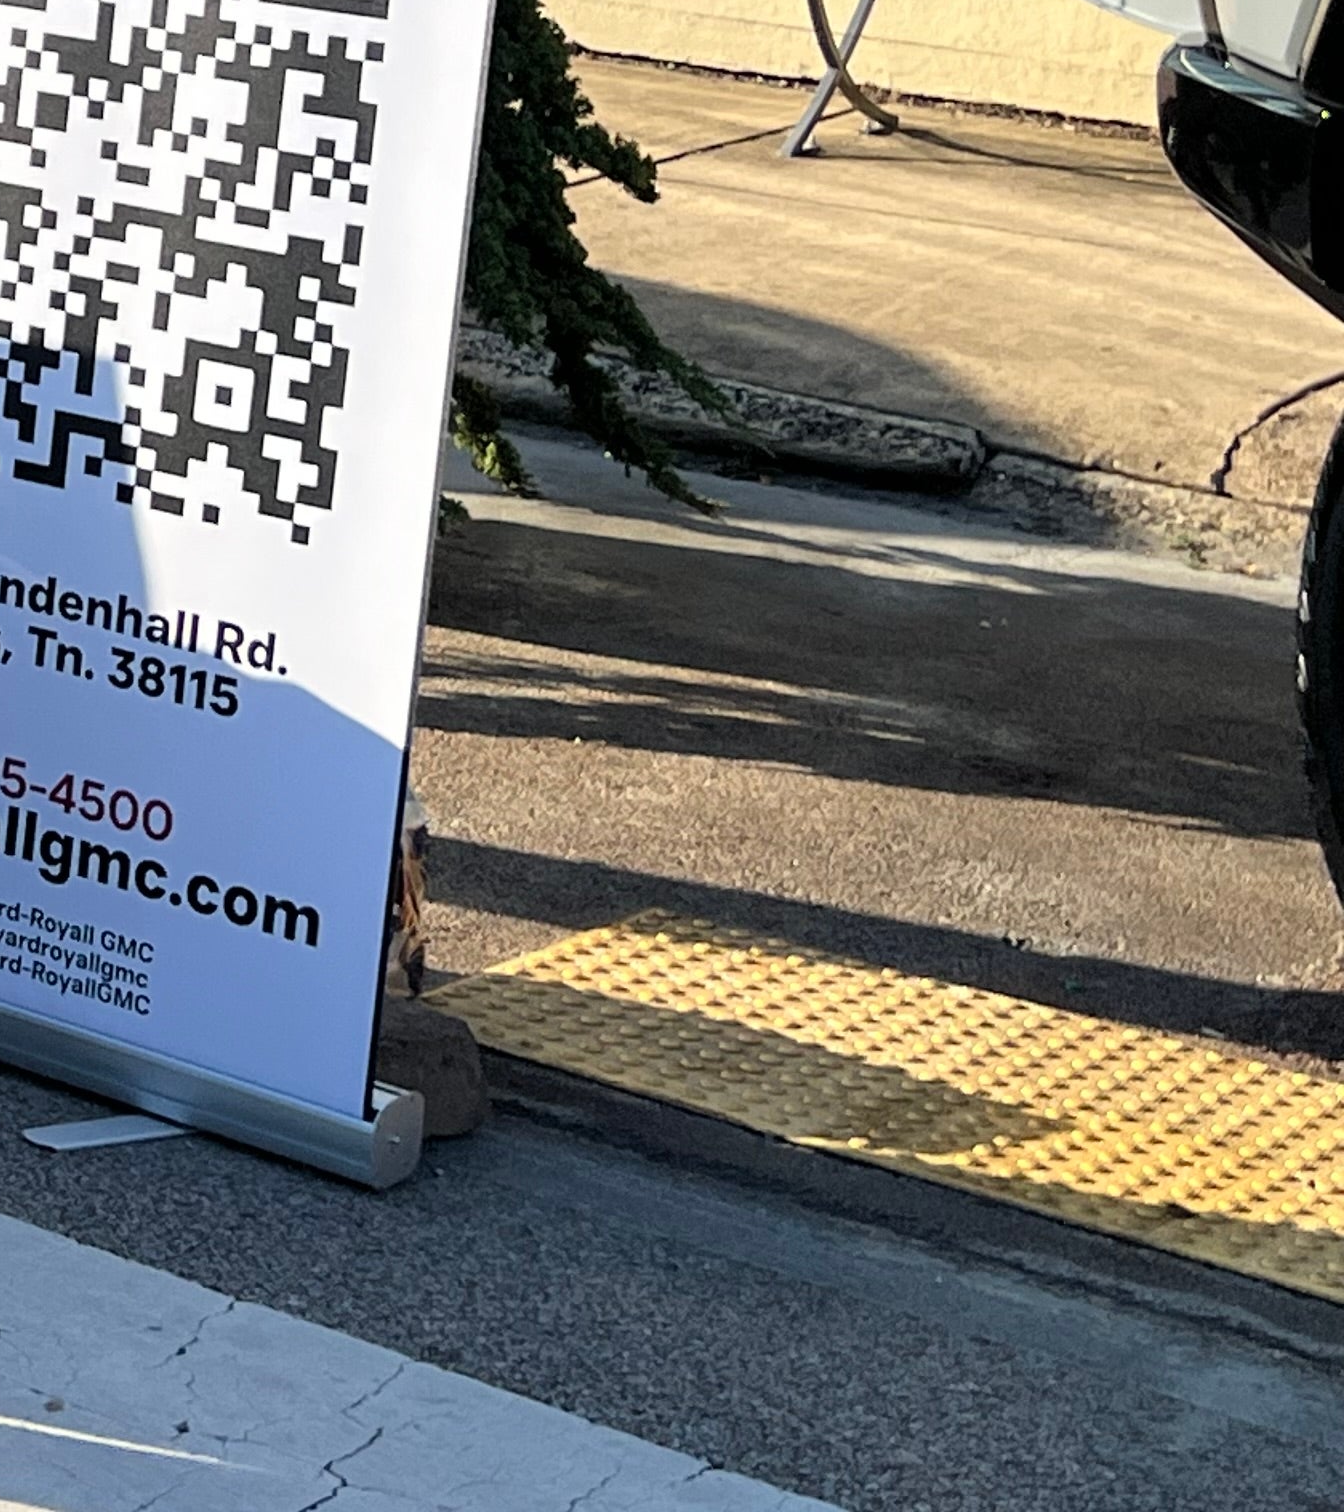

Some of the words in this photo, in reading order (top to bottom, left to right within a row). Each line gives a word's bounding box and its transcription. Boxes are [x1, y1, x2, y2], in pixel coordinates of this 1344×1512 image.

[28, 626, 94, 679] Tn.
[107, 647, 239, 717] 38115
[214, 621, 288, 676] Rd.
[100, 930, 154, 964] GMC
